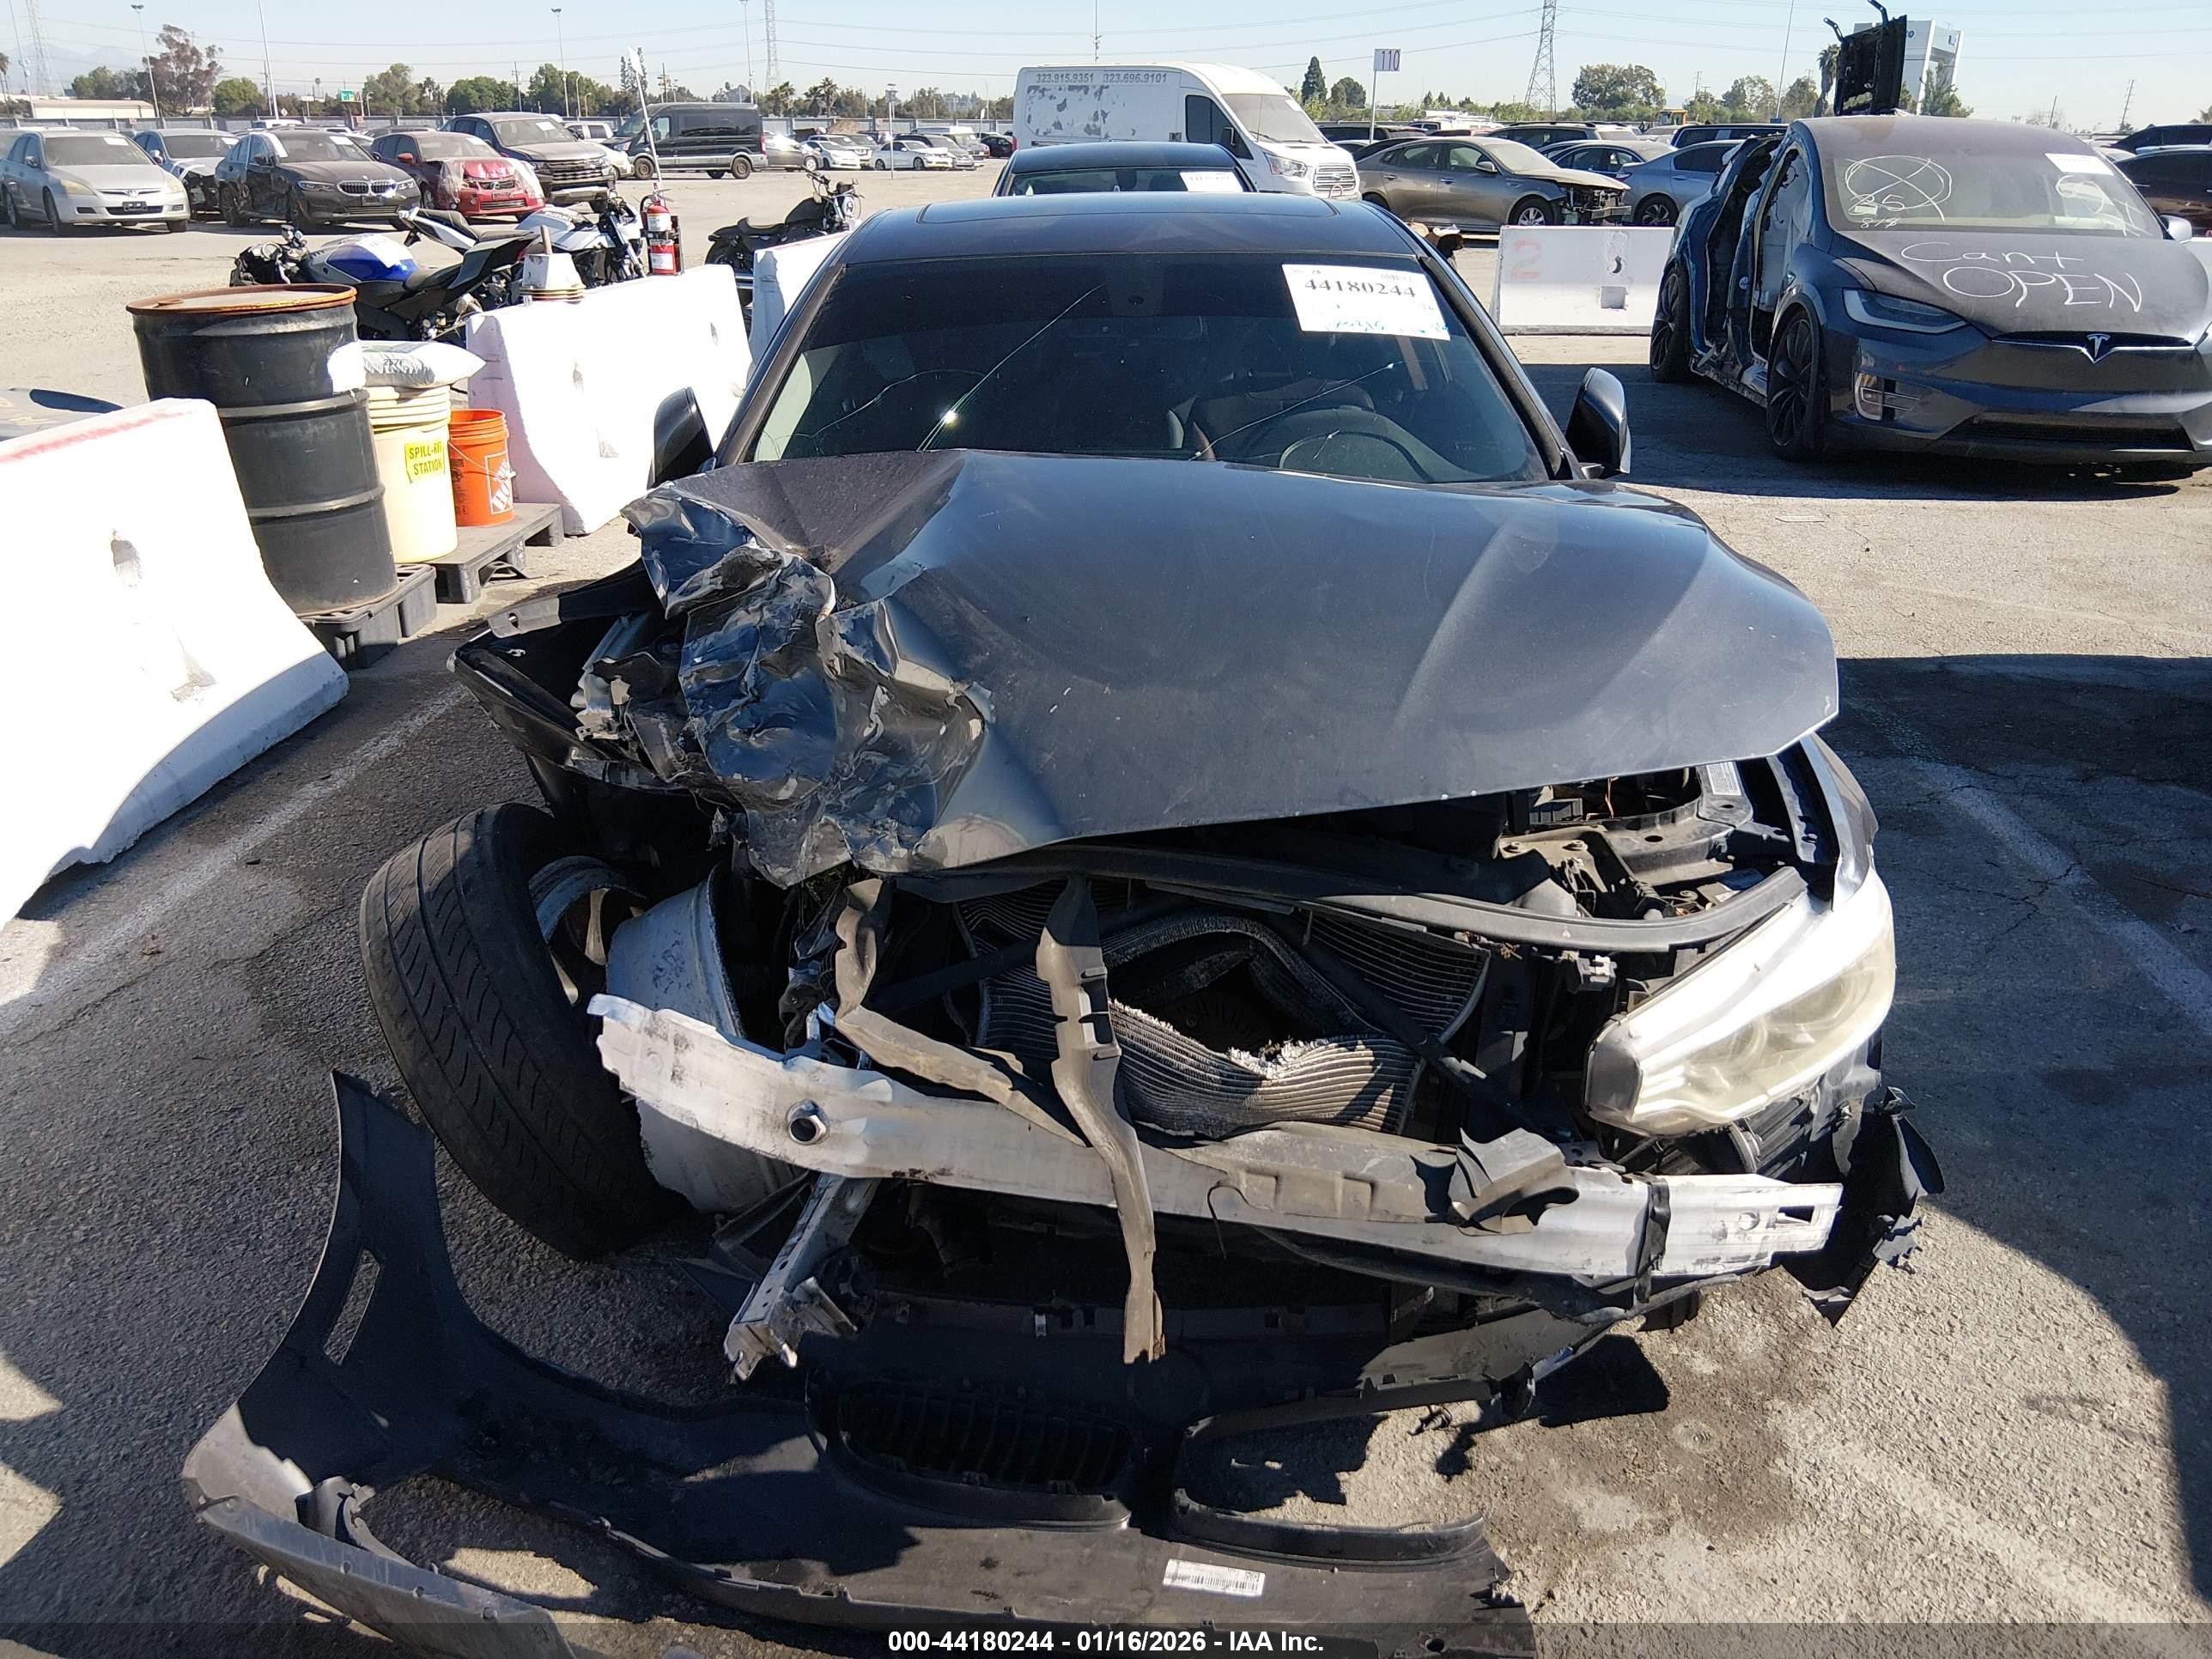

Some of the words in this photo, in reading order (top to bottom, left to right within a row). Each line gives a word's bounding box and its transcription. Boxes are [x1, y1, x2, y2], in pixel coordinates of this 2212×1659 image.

[1382, 49, 1401, 70] 110
[1036, 72, 1095, 83] 323.915.9351
[1103, 72, 1168, 83] 323.696.9101
[1304, 279, 1416, 298] 44180244
[1942, 266, 2142, 312] OPEN
[413, 458, 442, 475] STATION
